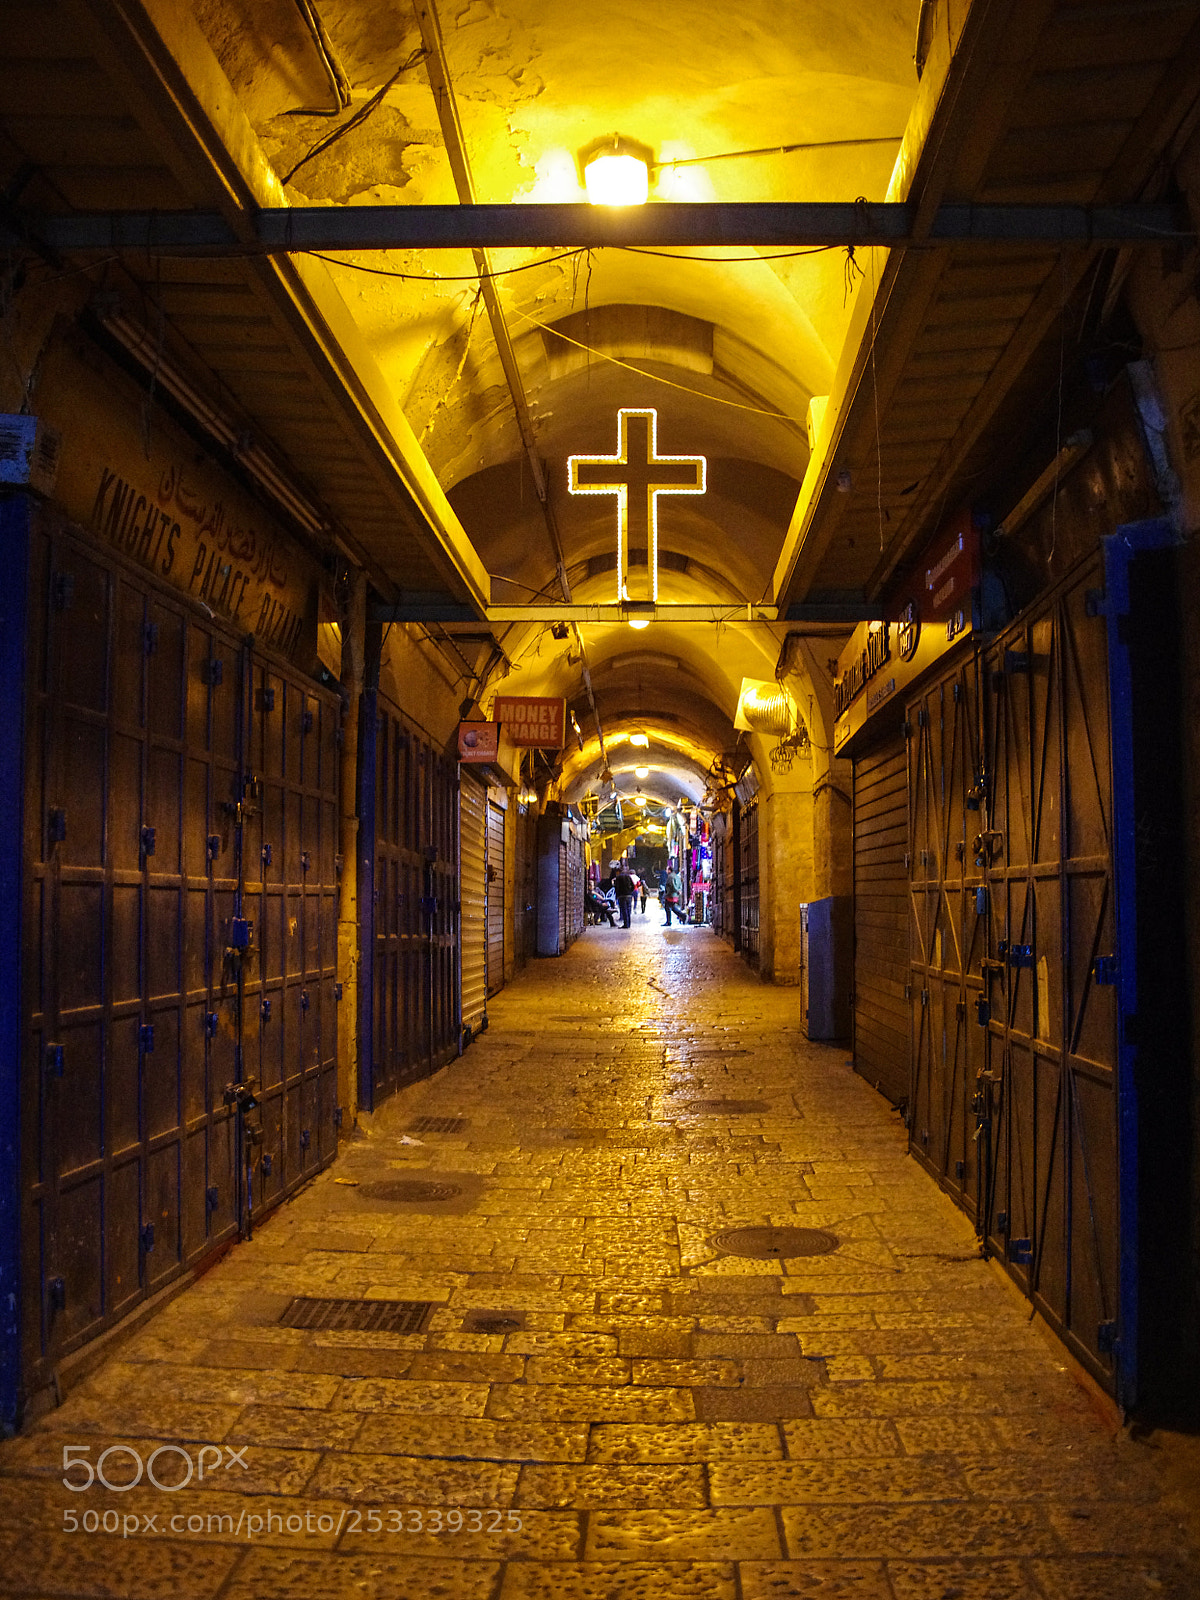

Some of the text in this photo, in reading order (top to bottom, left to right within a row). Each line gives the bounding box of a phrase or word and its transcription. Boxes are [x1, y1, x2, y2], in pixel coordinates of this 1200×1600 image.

[91, 466, 303, 658] KNIGHTS PALACE BAZAAR
[500, 703, 559, 723] MONEY
[506, 722, 558, 741] HANGE
